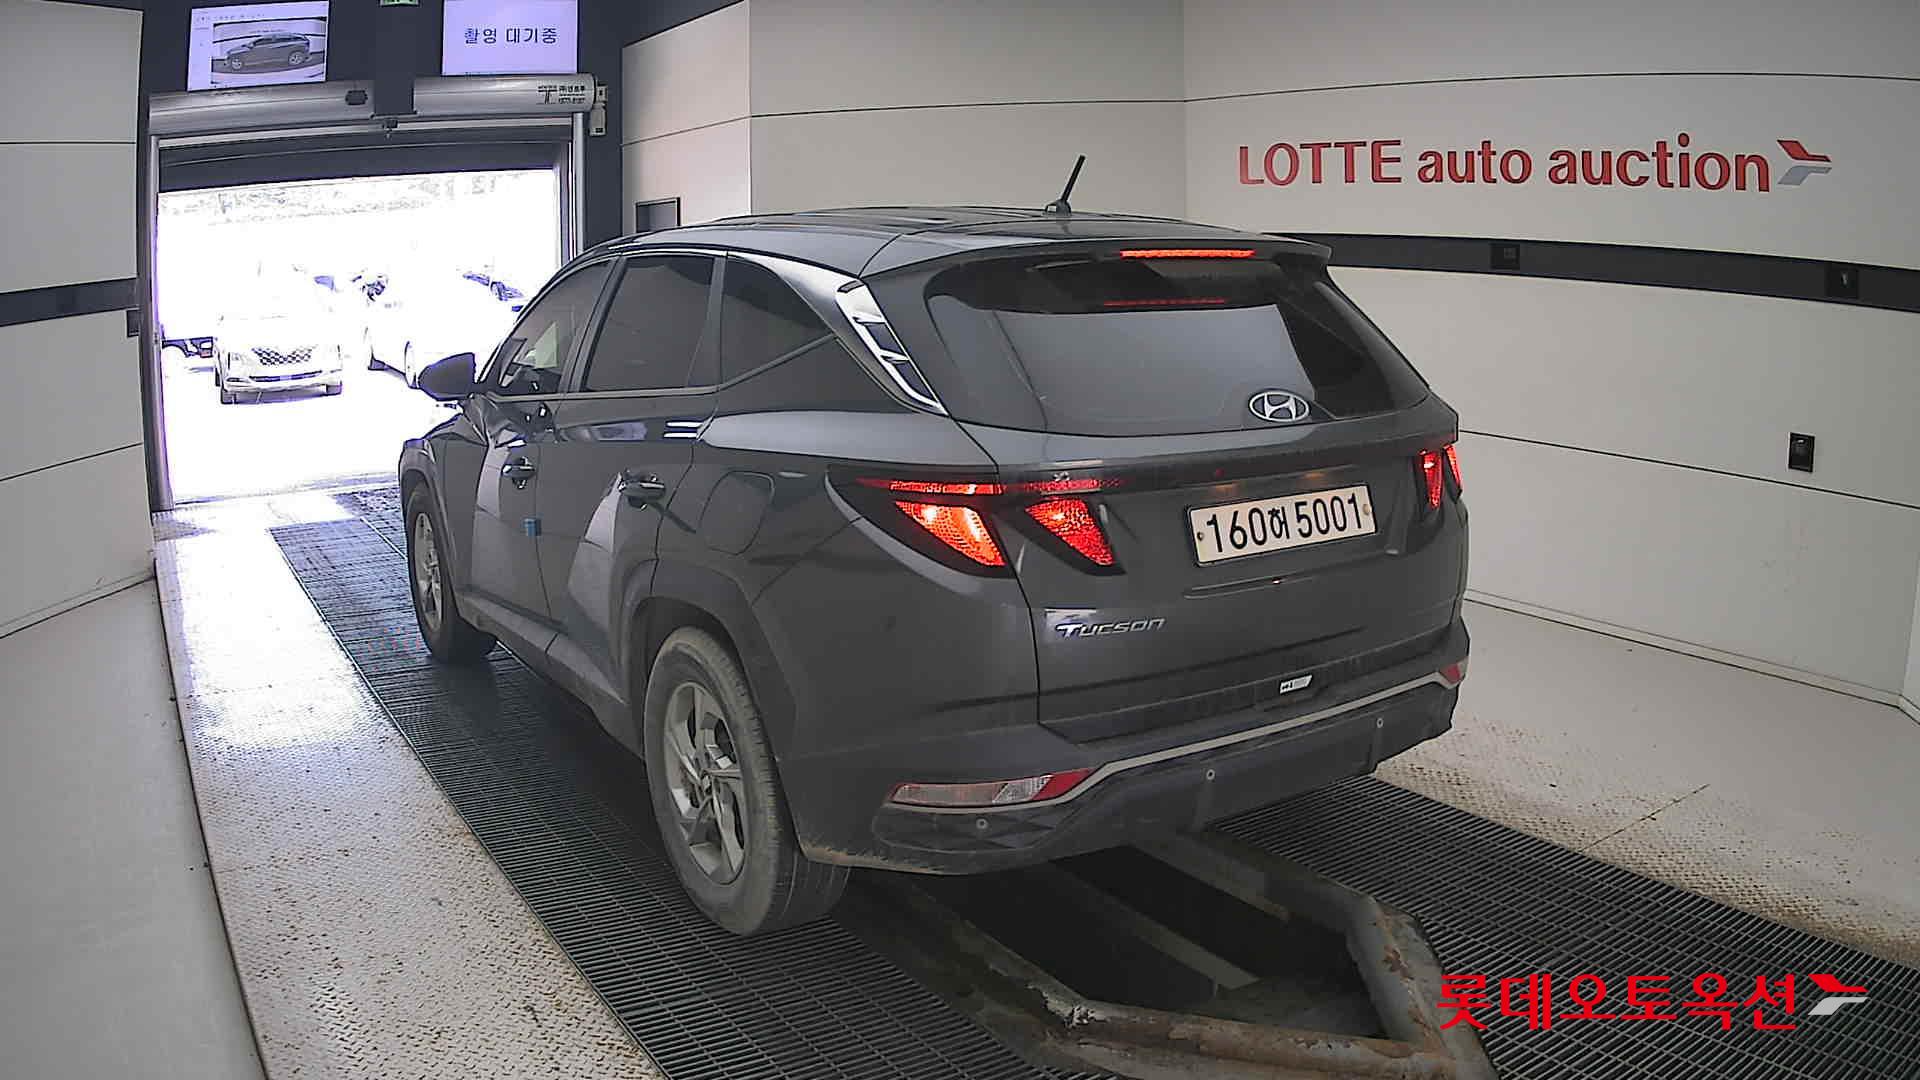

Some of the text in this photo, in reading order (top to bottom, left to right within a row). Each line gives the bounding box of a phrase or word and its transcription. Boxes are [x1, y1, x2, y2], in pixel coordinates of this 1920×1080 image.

[505, 27, 558, 44] 대기중
[1239, 132, 1770, 192] LOTTE auto auction
